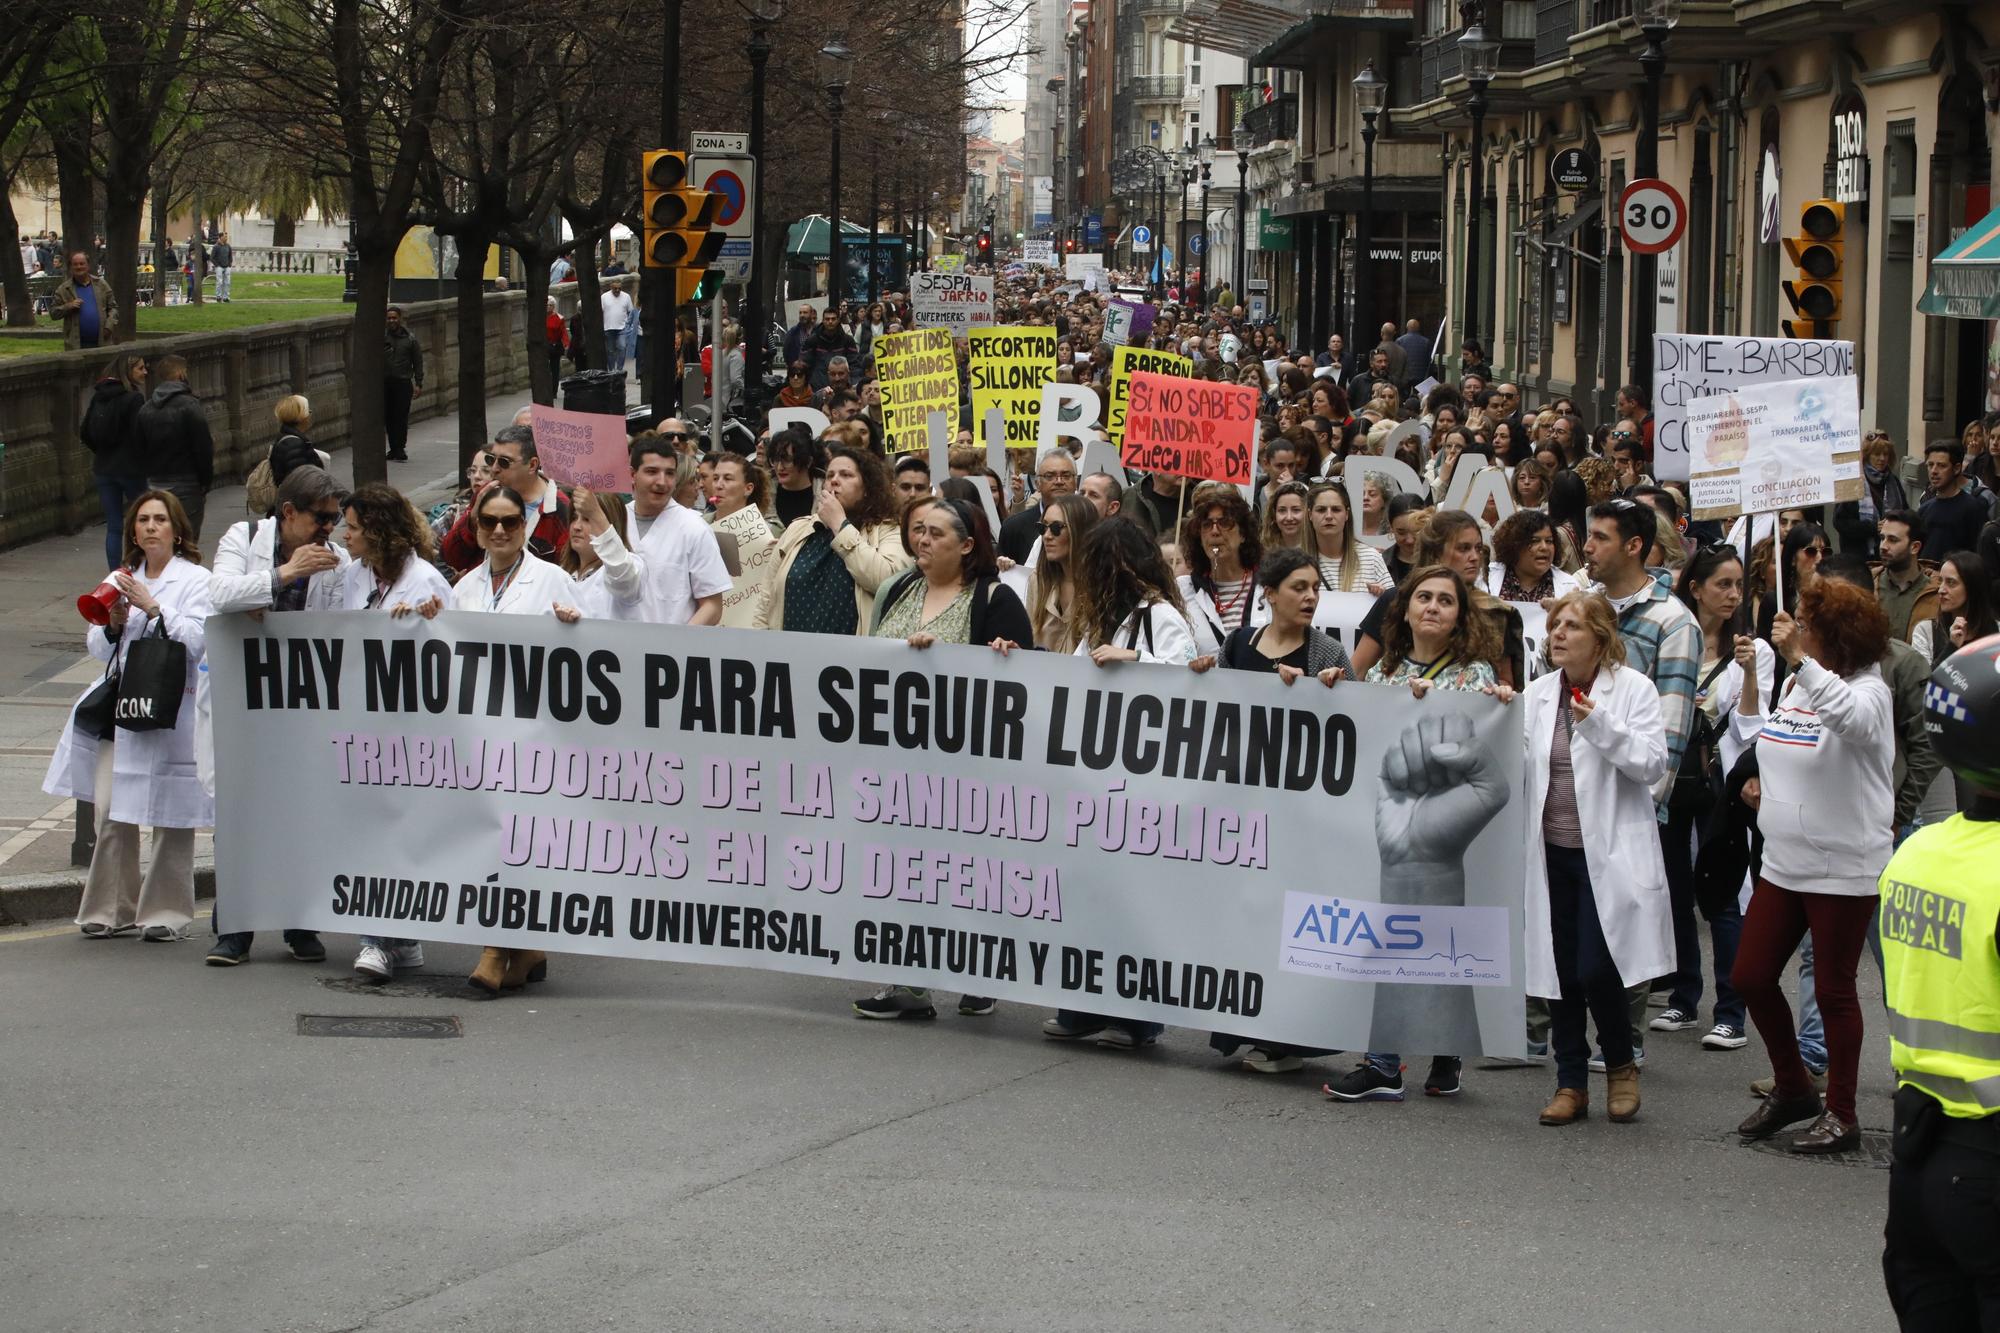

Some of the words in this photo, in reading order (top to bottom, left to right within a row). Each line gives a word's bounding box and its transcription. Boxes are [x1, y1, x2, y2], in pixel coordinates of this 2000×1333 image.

[696, 139, 725, 148] ZONA
[736, 141, 742, 150] 3
[1835, 111, 1862, 156] TACO
[1836, 158, 1860, 203] BELL
[1628, 203, 1671, 230] 30
[1370, 250, 1402, 260] www.
[919, 274, 972, 290] SESPA
[939, 288, 988, 302] JARRIO
[916, 312, 966, 322] ENFERMERAS
[874, 330, 952, 358] SOMETIDOS
[970, 336, 1056, 358] RECORTAD
[878, 353, 954, 382] ENGAÑADOS
[972, 362, 1055, 390] SILLONES
[1124, 352, 1190, 379] BARBÓN
[880, 377, 958, 405] SILENCIADOS
[1012, 400, 1041, 415] NO
[1160, 389, 1182, 414] NO
[1188, 388, 1251, 422] SABES
[1688, 412, 1723, 422] TRABAJAR
[1724, 410, 1734, 418] EN
[1736, 408, 1744, 416] EL
[1746, 404, 1768, 414] SESPA
[536, 417, 593, 440] NUESTROS
[1130, 416, 1224, 450] MANDAR,
[1696, 426, 1704, 434] EL
[1706, 420, 1742, 432] INFIERNO
[1743, 418, 1753, 426] EN
[1754, 417, 1762, 425] EL
[1714, 431, 1746, 443] PARAÍSO
[1771, 422, 1832, 438] TRANSPARENCIA
[1811, 434, 1820, 442] LA
[1822, 430, 1858, 442] GERENCIA
[886, 427, 954, 452] AGOTAS
[1186, 448, 1213, 478] HAS
[1700, 480, 1730, 488] VOCACIÓN
[1752, 476, 1821, 494] CONCILIACIÓN
[1752, 499, 1768, 510] SIN
[1770, 492, 1820, 507] COACCIÓN
[720, 506, 761, 531] SOMOS
[737, 523, 766, 548] ESES
[741, 548, 774, 573] MOS
[1950, 670, 1968, 691] Gijón
[243, 638, 344, 711] HAY
[363, 638, 622, 726] MOTIVOS
[644, 653, 796, 738] PARA
[818, 666, 1028, 761] SEGUIR
[1046, 686, 1357, 796] LUCHANDO
[331, 732, 685, 806] TRABAJADORXS
[701, 756, 762, 812] DE
[780, 760, 834, 818] LA
[851, 767, 1050, 842] SANIDAD
[1066, 778, 1268, 870] PÚBLICA
[500, 812, 690, 880] UNIDXS
[706, 829, 767, 886] EN
[785, 835, 845, 894] SU
[862, 842, 1062, 922] DEFENSA
[1884, 880, 1961, 928] POLICIA
[1293, 898, 1424, 950] ATAS
[1889, 913, 1950, 954] LOCAL
[332, 874, 449, 923] SANIDAD
[456, 872, 614, 938] PÚBLICA
[630, 898, 840, 965] UNIVERSAL,
[854, 919, 1017, 980] GRATUITA
[1028, 941, 1050, 986] Y
[1061, 946, 1104, 994] DE
[1116, 954, 1264, 1018] CALIDAD
